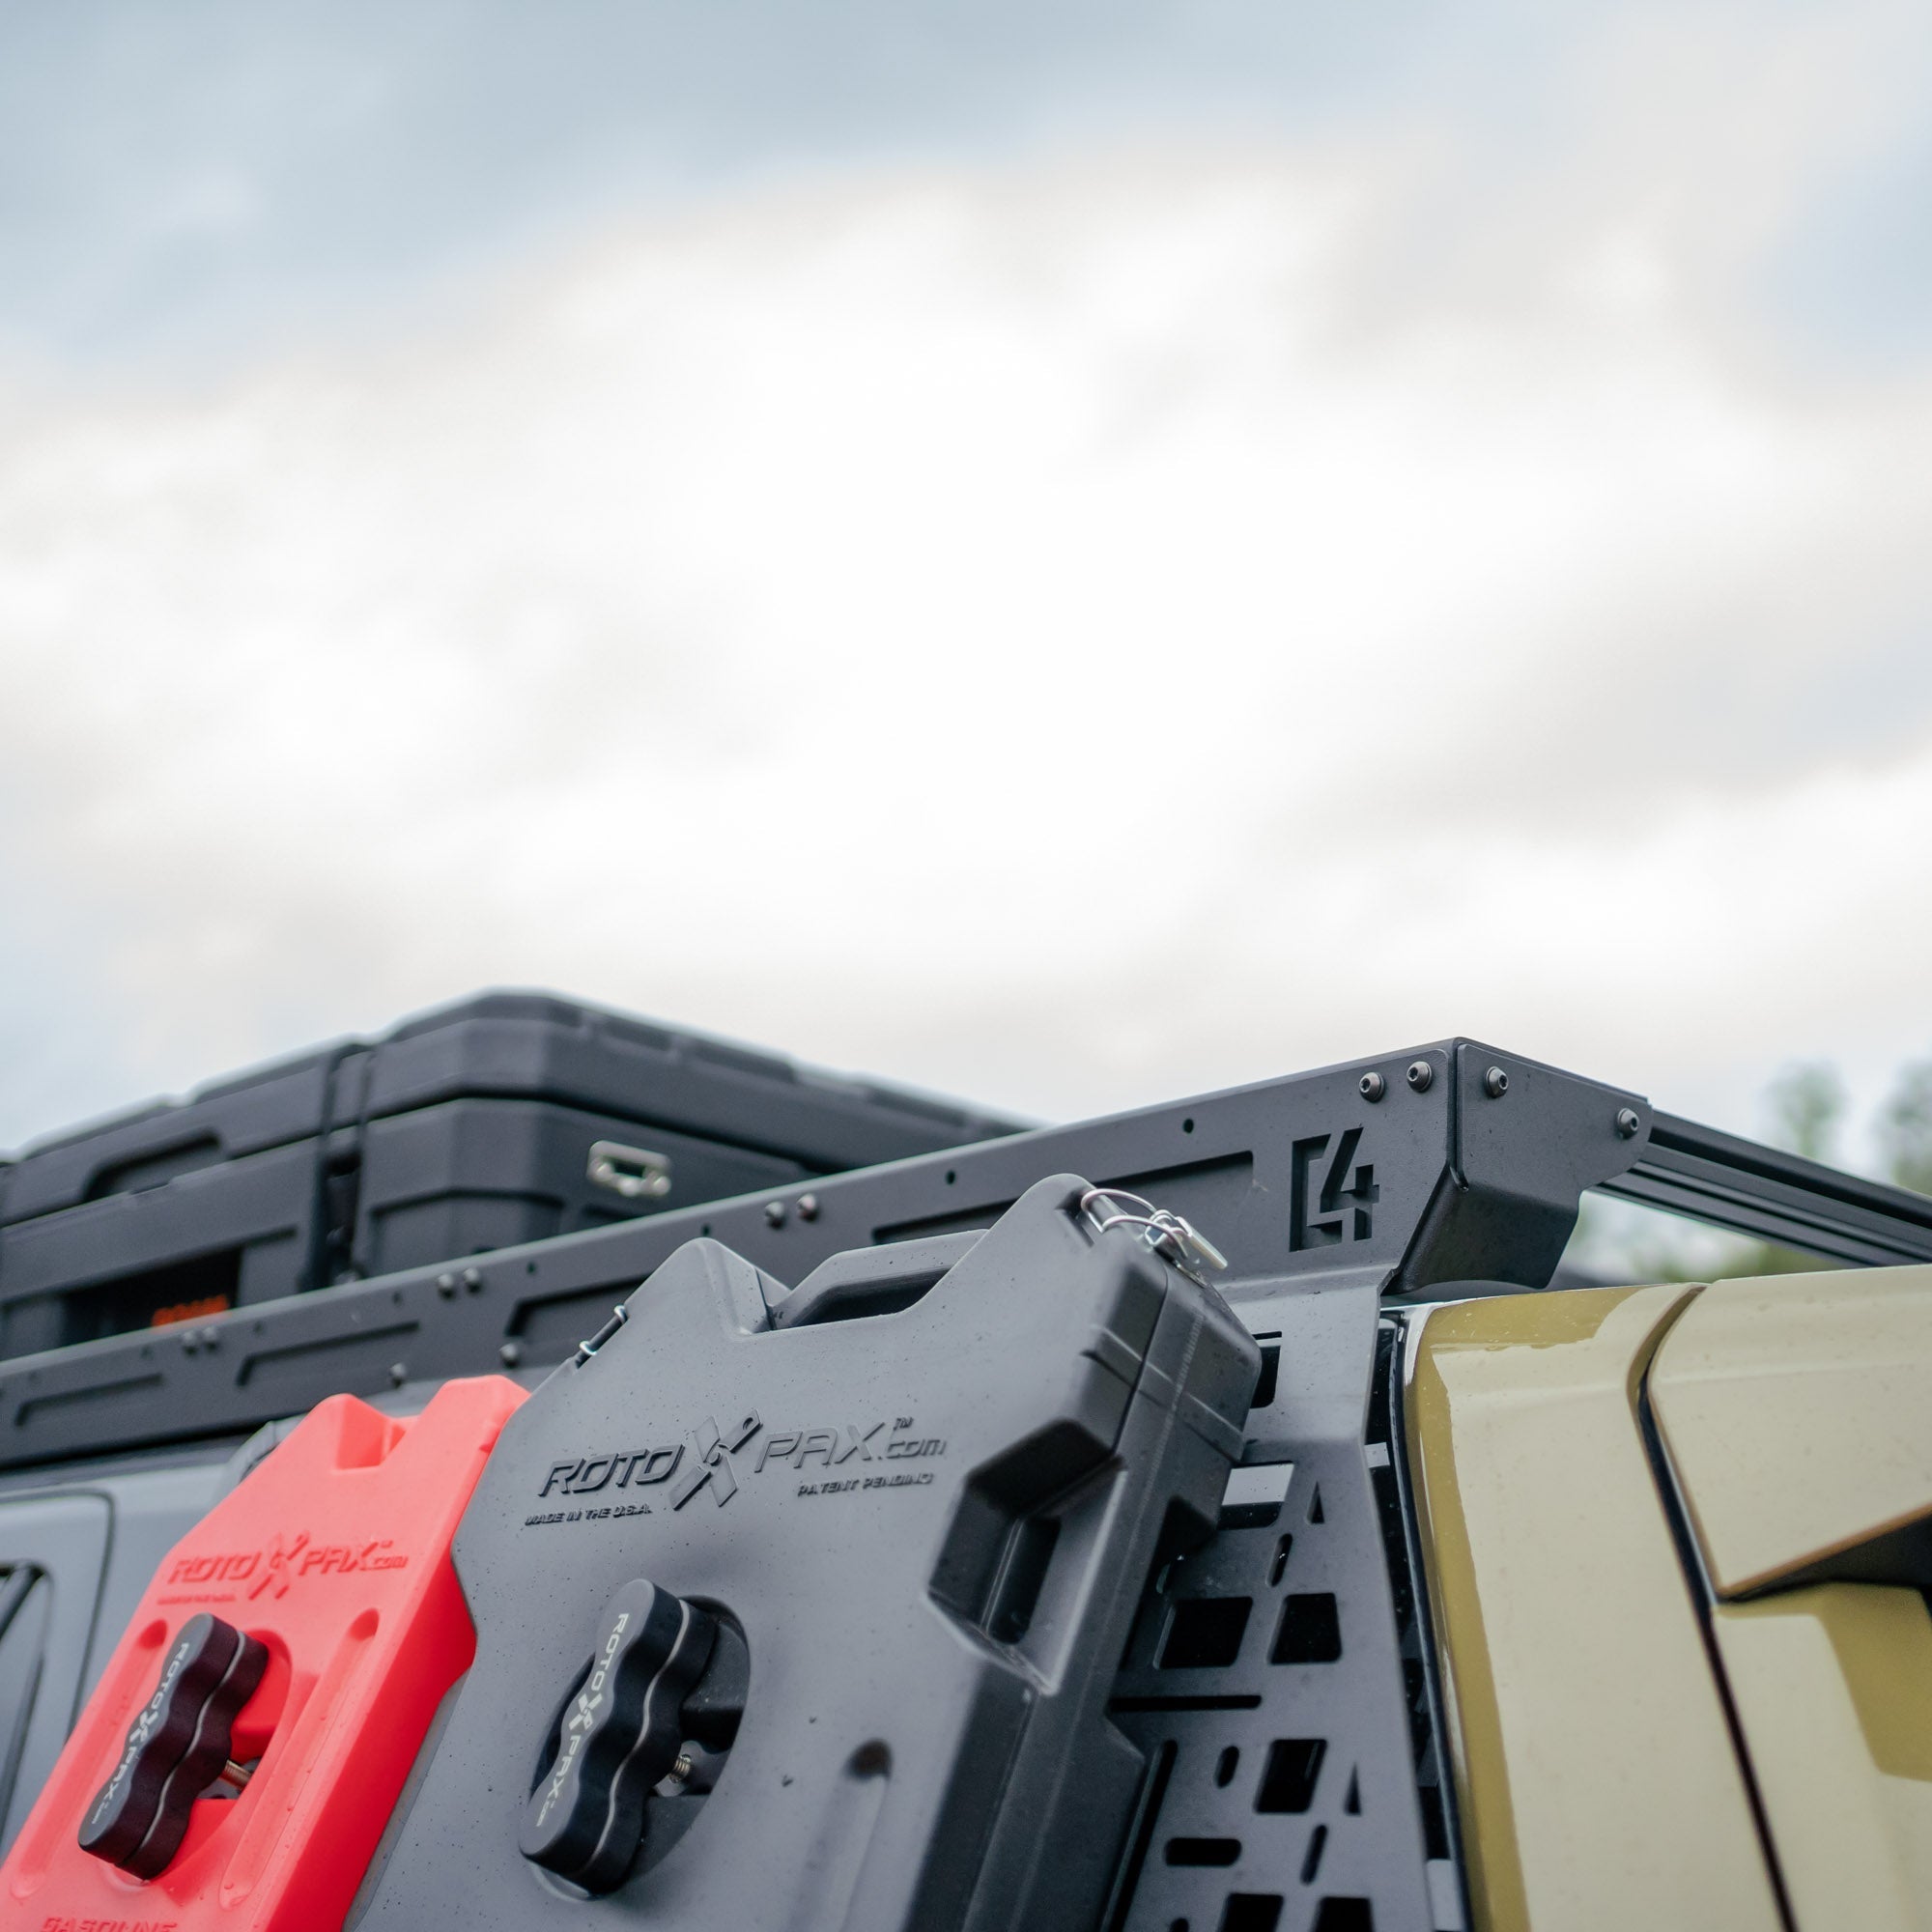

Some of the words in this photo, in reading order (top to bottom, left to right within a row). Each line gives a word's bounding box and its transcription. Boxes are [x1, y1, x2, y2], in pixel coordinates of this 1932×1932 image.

[798, 1479, 860, 1496] PATENT
[862, 1473, 934, 1490] PENDING
[525, 1513, 565, 1526] MADE
[566, 1508, 582, 1521] IN
[585, 1508, 611, 1520] THE
